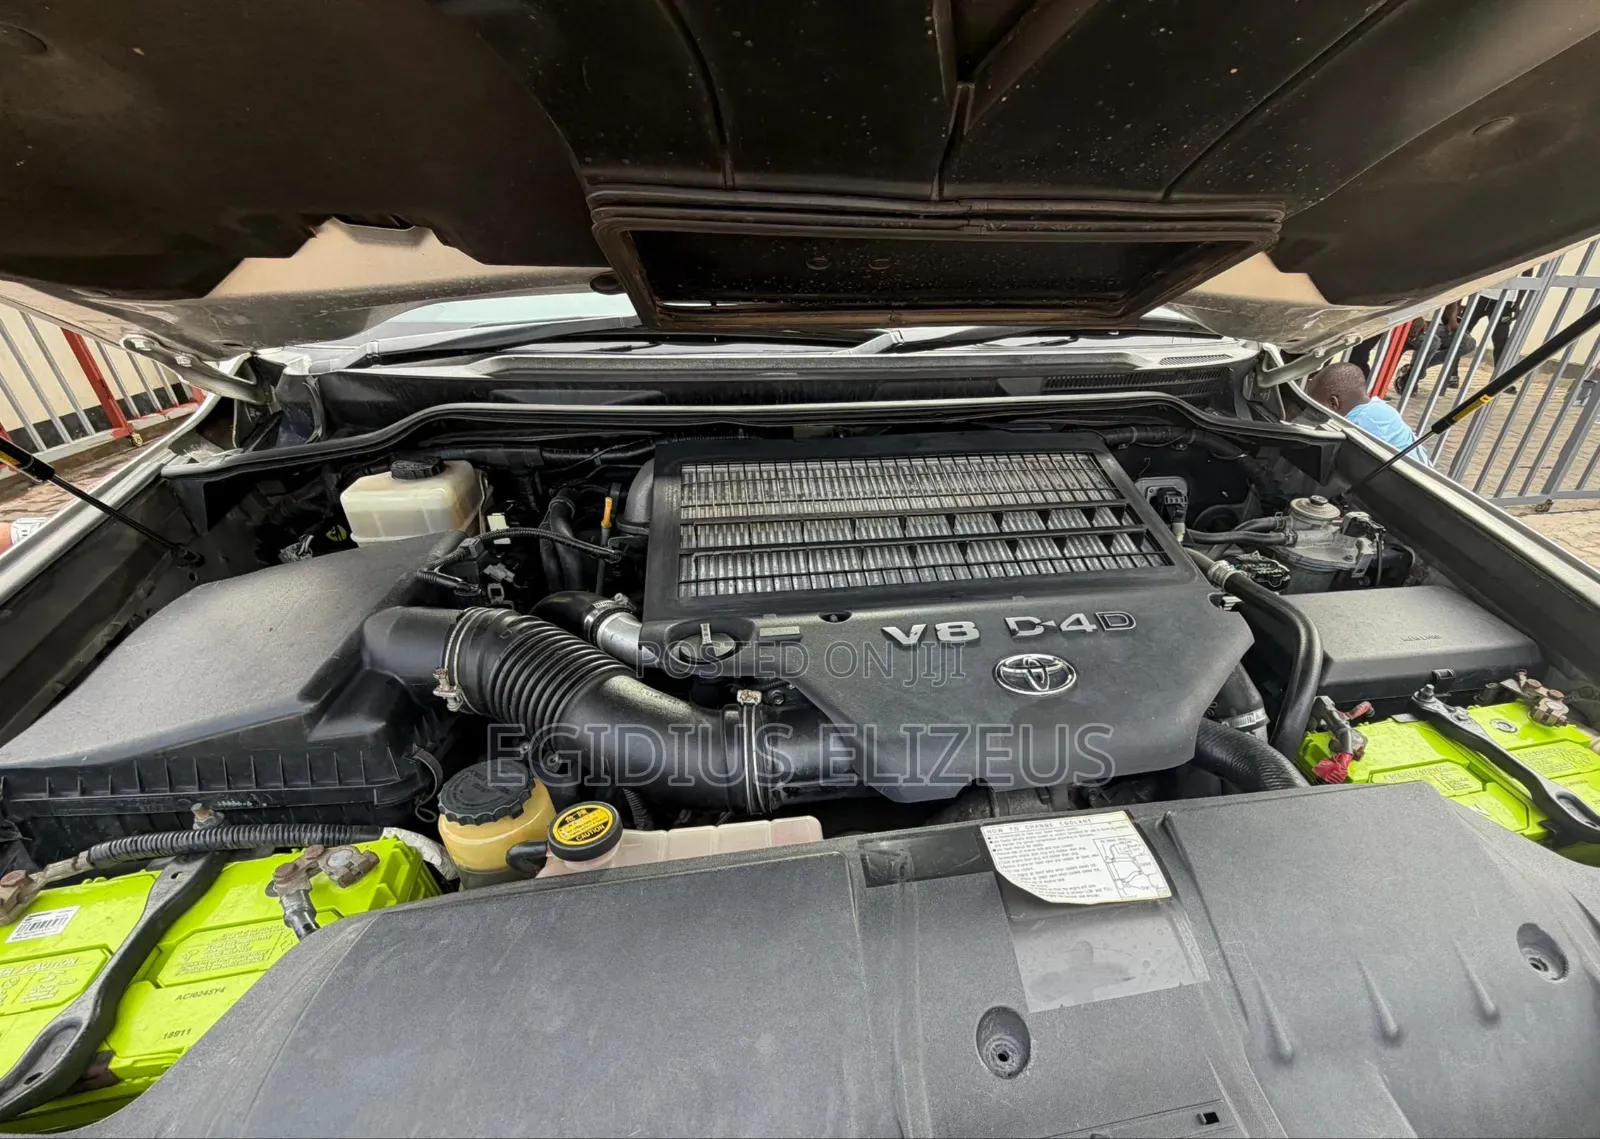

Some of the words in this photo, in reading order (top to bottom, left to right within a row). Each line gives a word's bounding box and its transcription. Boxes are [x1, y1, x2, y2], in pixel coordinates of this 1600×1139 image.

[882, 621, 980, 647] V8
[1003, 610, 1137, 638] D-4D
[1059, 818, 1092, 827] COOLANT
[575, 823, 605, 842] CAUTION
